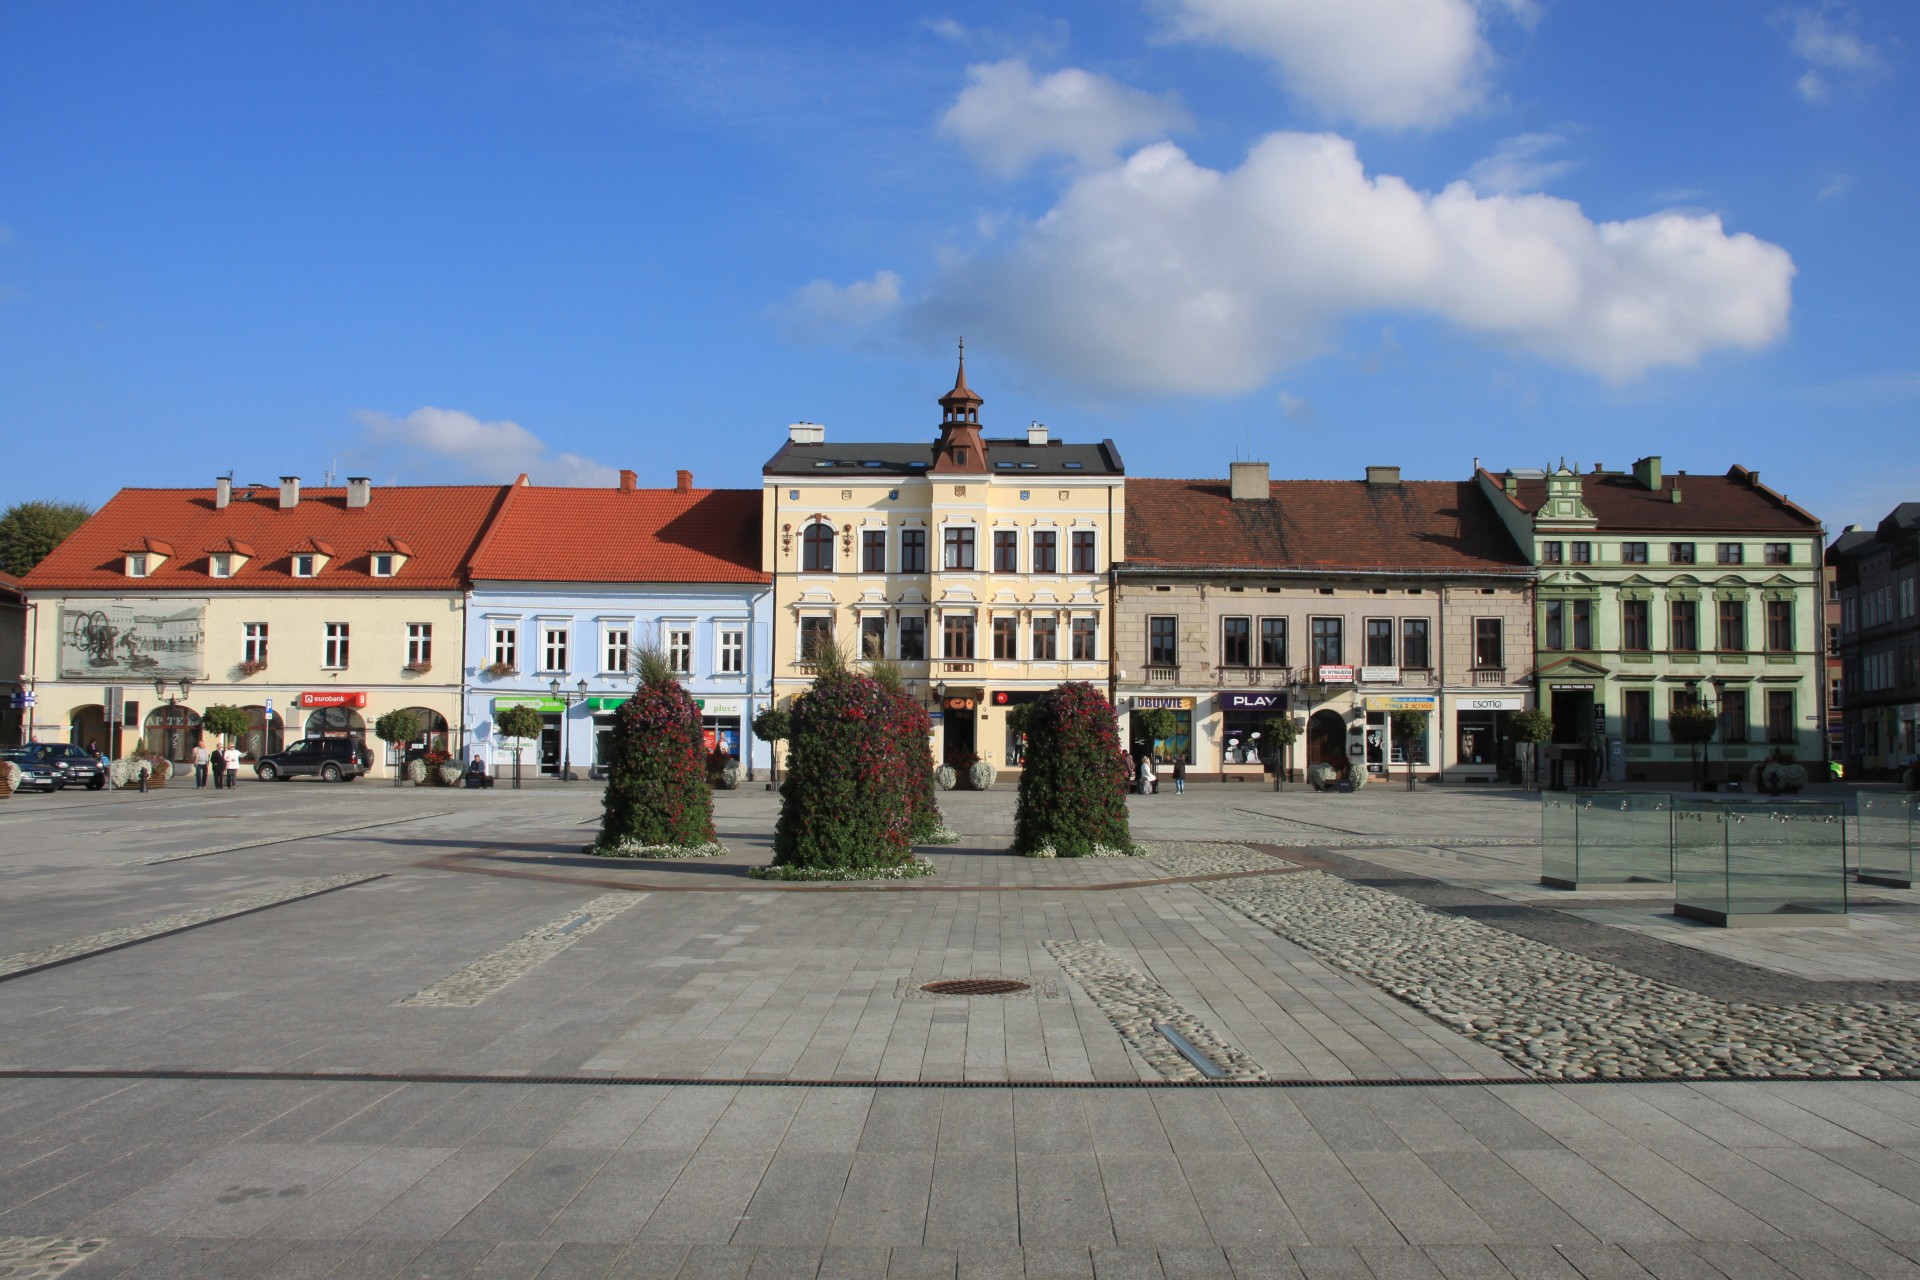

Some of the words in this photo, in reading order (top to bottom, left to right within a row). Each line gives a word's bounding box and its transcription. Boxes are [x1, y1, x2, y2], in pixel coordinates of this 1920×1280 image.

[1233, 696, 1277, 706] PLAY
[1472, 700, 1502, 709] ESOTIQ
[713, 704, 731, 713] plus
[148, 716, 201, 726] APTEK
